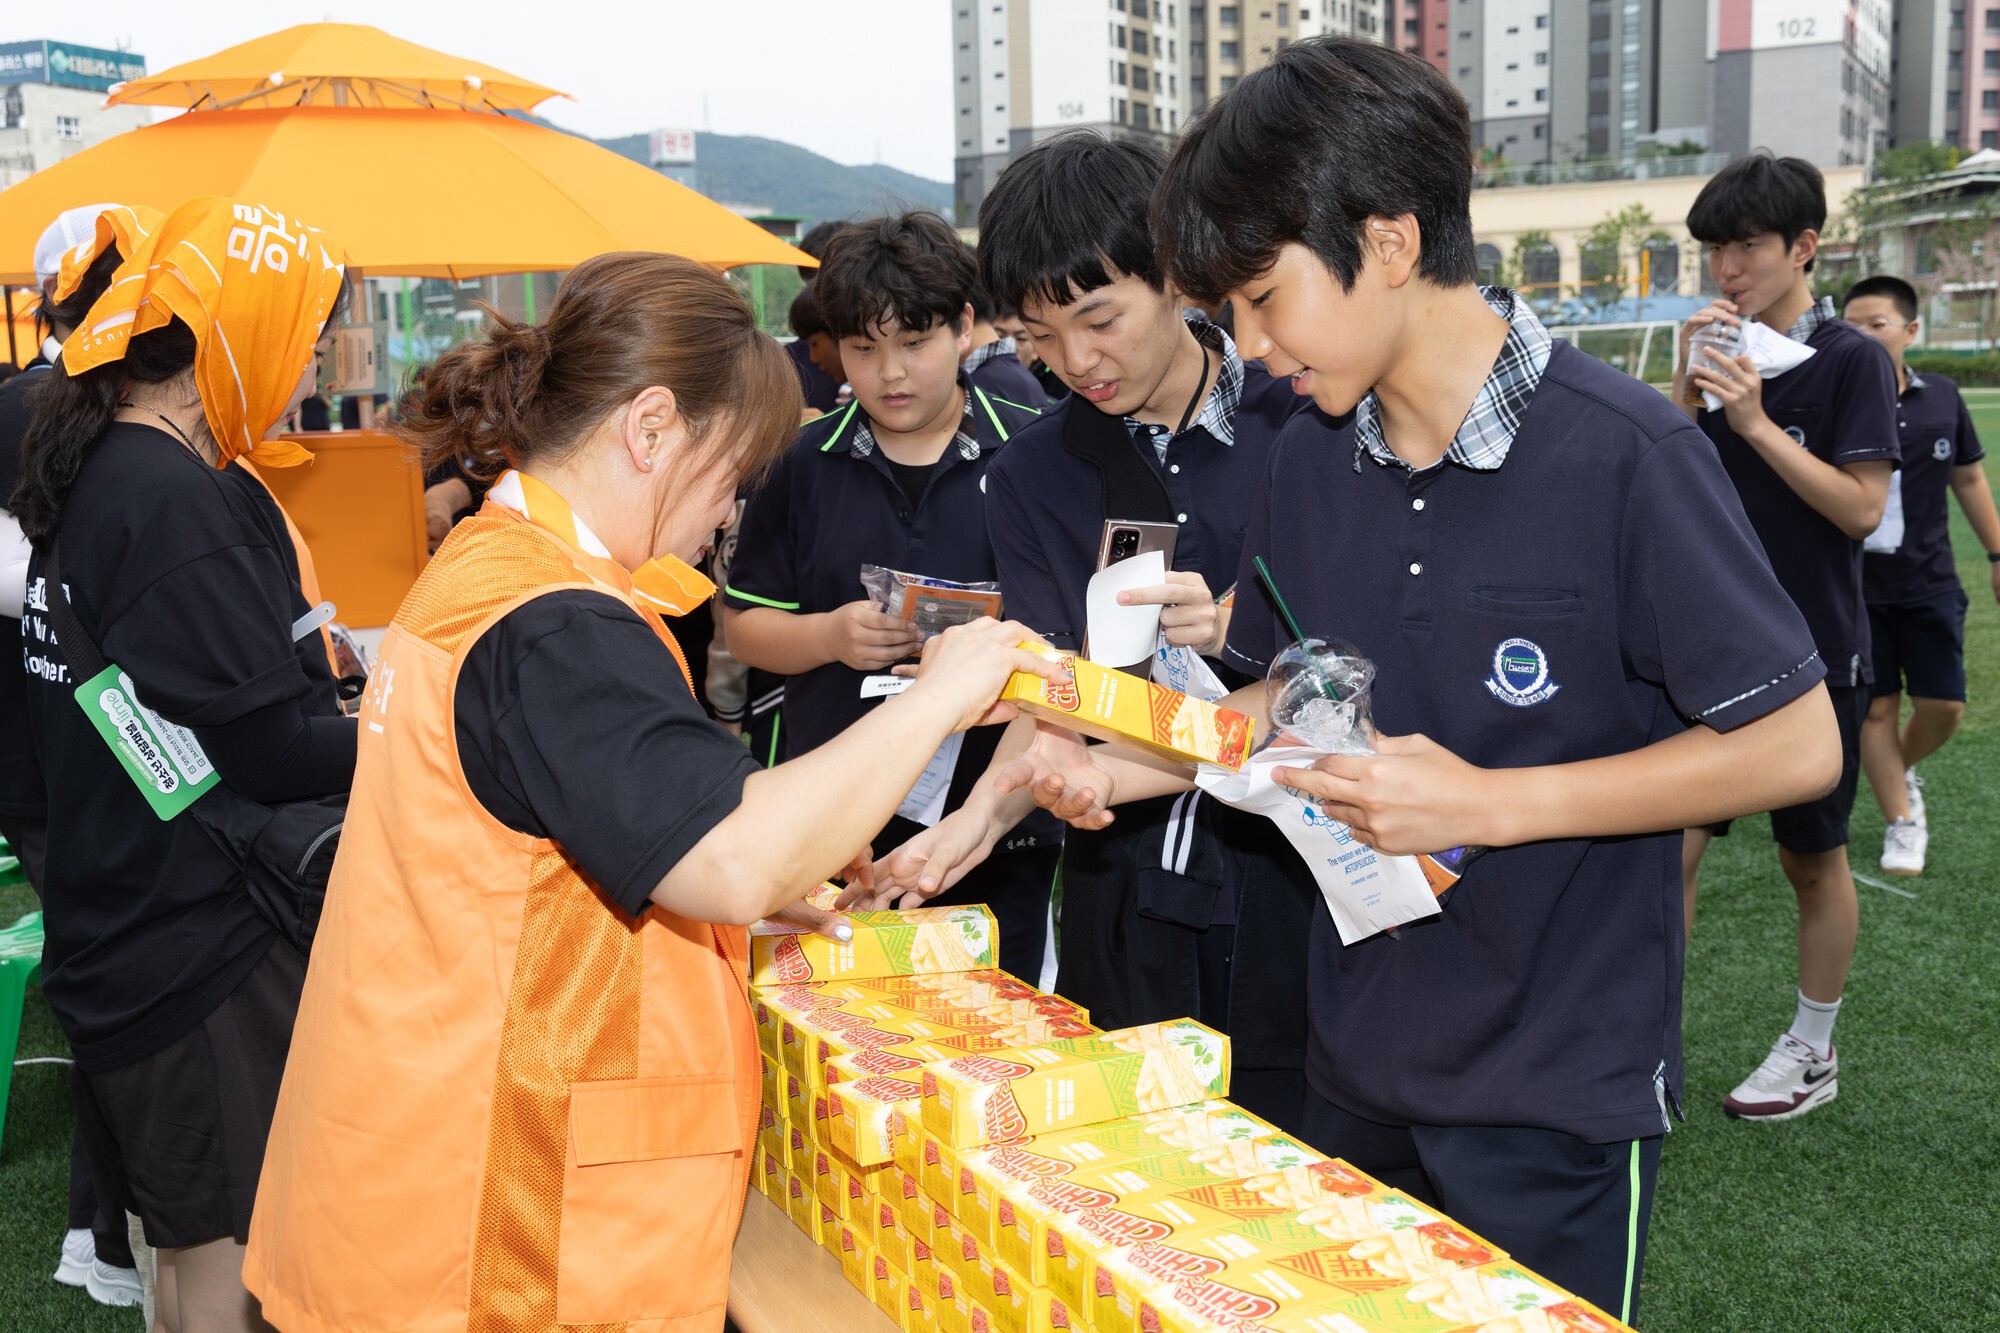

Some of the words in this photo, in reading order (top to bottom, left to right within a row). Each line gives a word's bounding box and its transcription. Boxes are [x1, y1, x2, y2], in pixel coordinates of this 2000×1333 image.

[1776, 17, 1816, 39] 102
[1058, 101, 1084, 118] 104
[106, 692, 130, 723] lime
[1497, 687, 1519, 703] SINCE
[150, 758, 176, 790] 청소년
[1327, 858, 1338, 867] The
[1337, 851, 1355, 863] reason
[1354, 848, 1361, 856] we
[1361, 844, 1374, 852] wal
[1345, 854, 1377, 875] #STOPSUICIDE
[775, 942, 790, 982] MEGA
[786, 933, 814, 982] CHIPS
[817, 1008, 877, 1029] CHIPS
[840, 1028, 880, 1052] MEGA
[852, 1025, 914, 1047] CHIPS
[850, 1052, 893, 1076] MEGA
[863, 1049, 926, 1071] CHIPS
[950, 1059, 999, 1083] MEGA
[962, 1054, 1034, 1080] CHIPS
[851, 1082, 896, 1103] MEGA
[985, 1090, 1002, 1142] MEGA
[999, 1079, 1027, 1142] CHIPS
[987, 1154, 1040, 1183] MEGA
[1002, 1147, 1076, 1177] CHIPS
[1028, 1182, 1079, 1215] MEGA
[1040, 1176, 1120, 1209] CHIPS
[1077, 1210, 1132, 1248] MEGA
[1087, 1205, 1174, 1243] CHIPS
[1127, 1252, 1182, 1284] MEGA
[1140, 1242, 1228, 1278] CHIPS
[1174, 1287, 1238, 1327] MEGA
[1184, 1274, 1280, 1320] CHIPS
